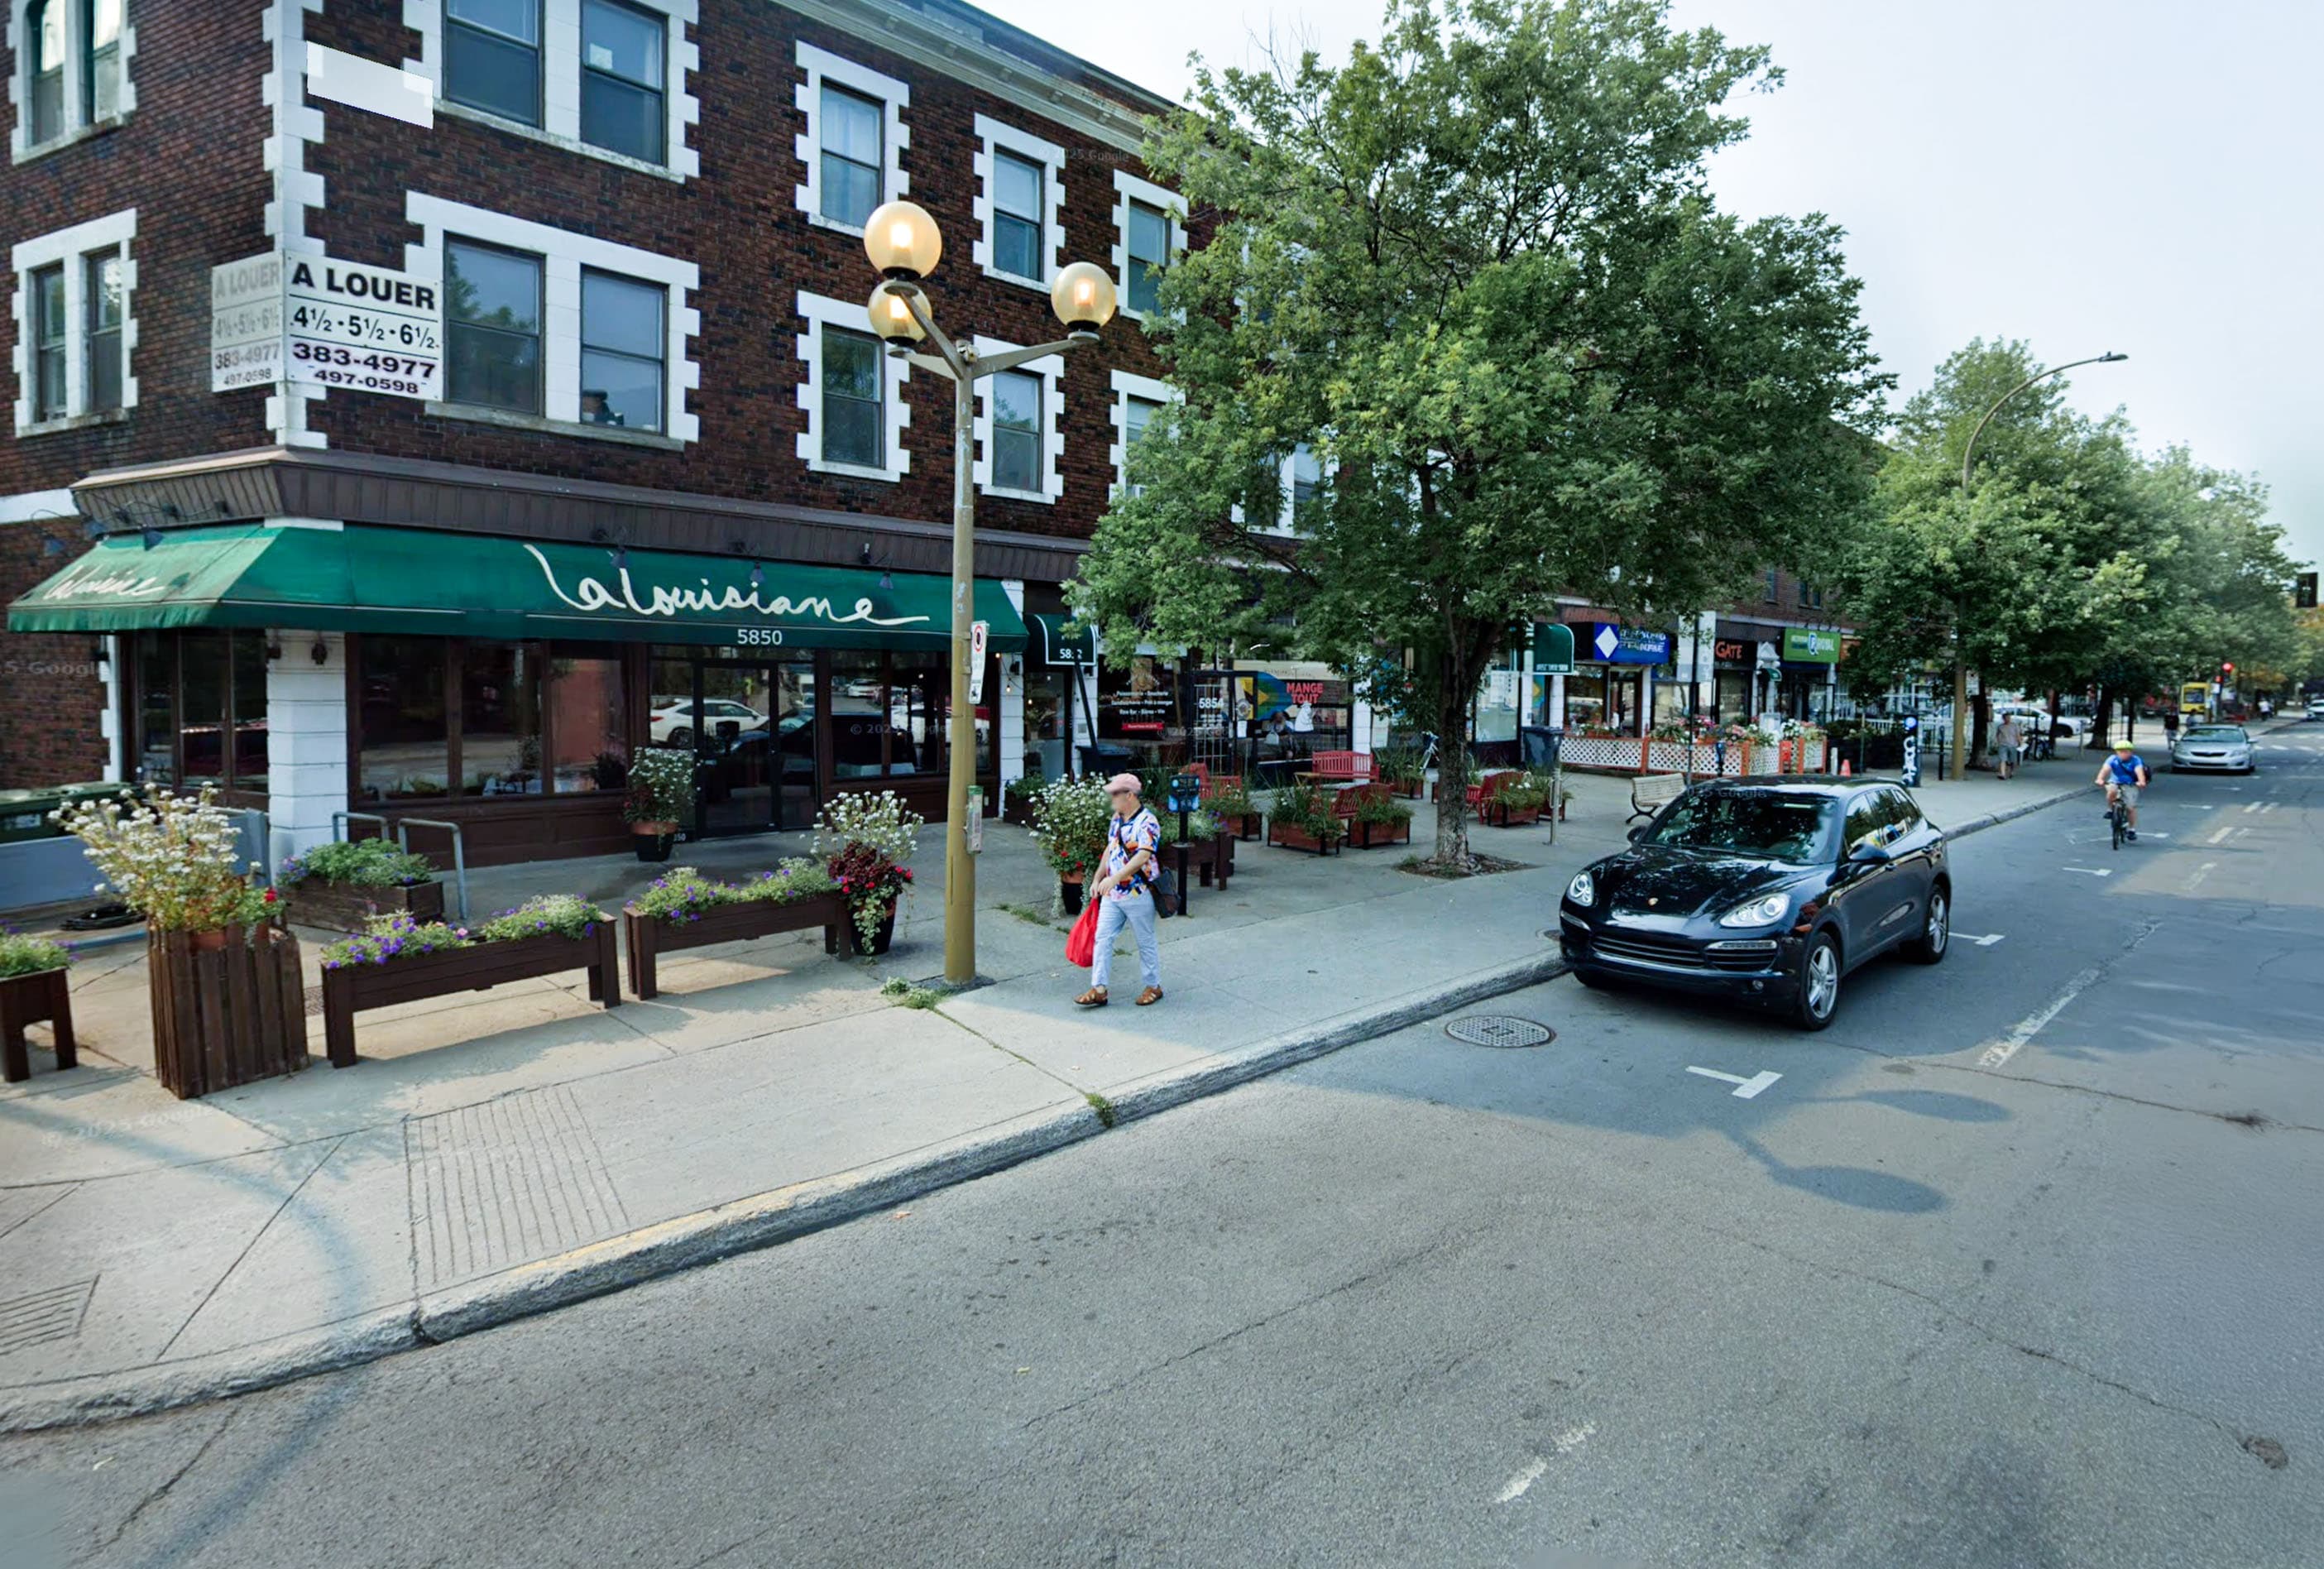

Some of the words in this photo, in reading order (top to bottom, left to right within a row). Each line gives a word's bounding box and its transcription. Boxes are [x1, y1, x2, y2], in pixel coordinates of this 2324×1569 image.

[229, 262, 280, 295] LOUER
[292, 263, 315, 288] A
[326, 267, 436, 310] LOUER
[214, 343, 280, 370] 383-4977
[292, 343, 436, 378] 383-4977
[224, 367, 272, 386] 497-0598
[314, 369, 419, 394] 497-0598
[737, 630, 783, 646] 5850
[1060, 648, 1083, 660] 582
[1287, 682, 1324, 693] MANGE
[1199, 698, 1224, 709] 5854
[1291, 693, 1320, 704] TOUT
